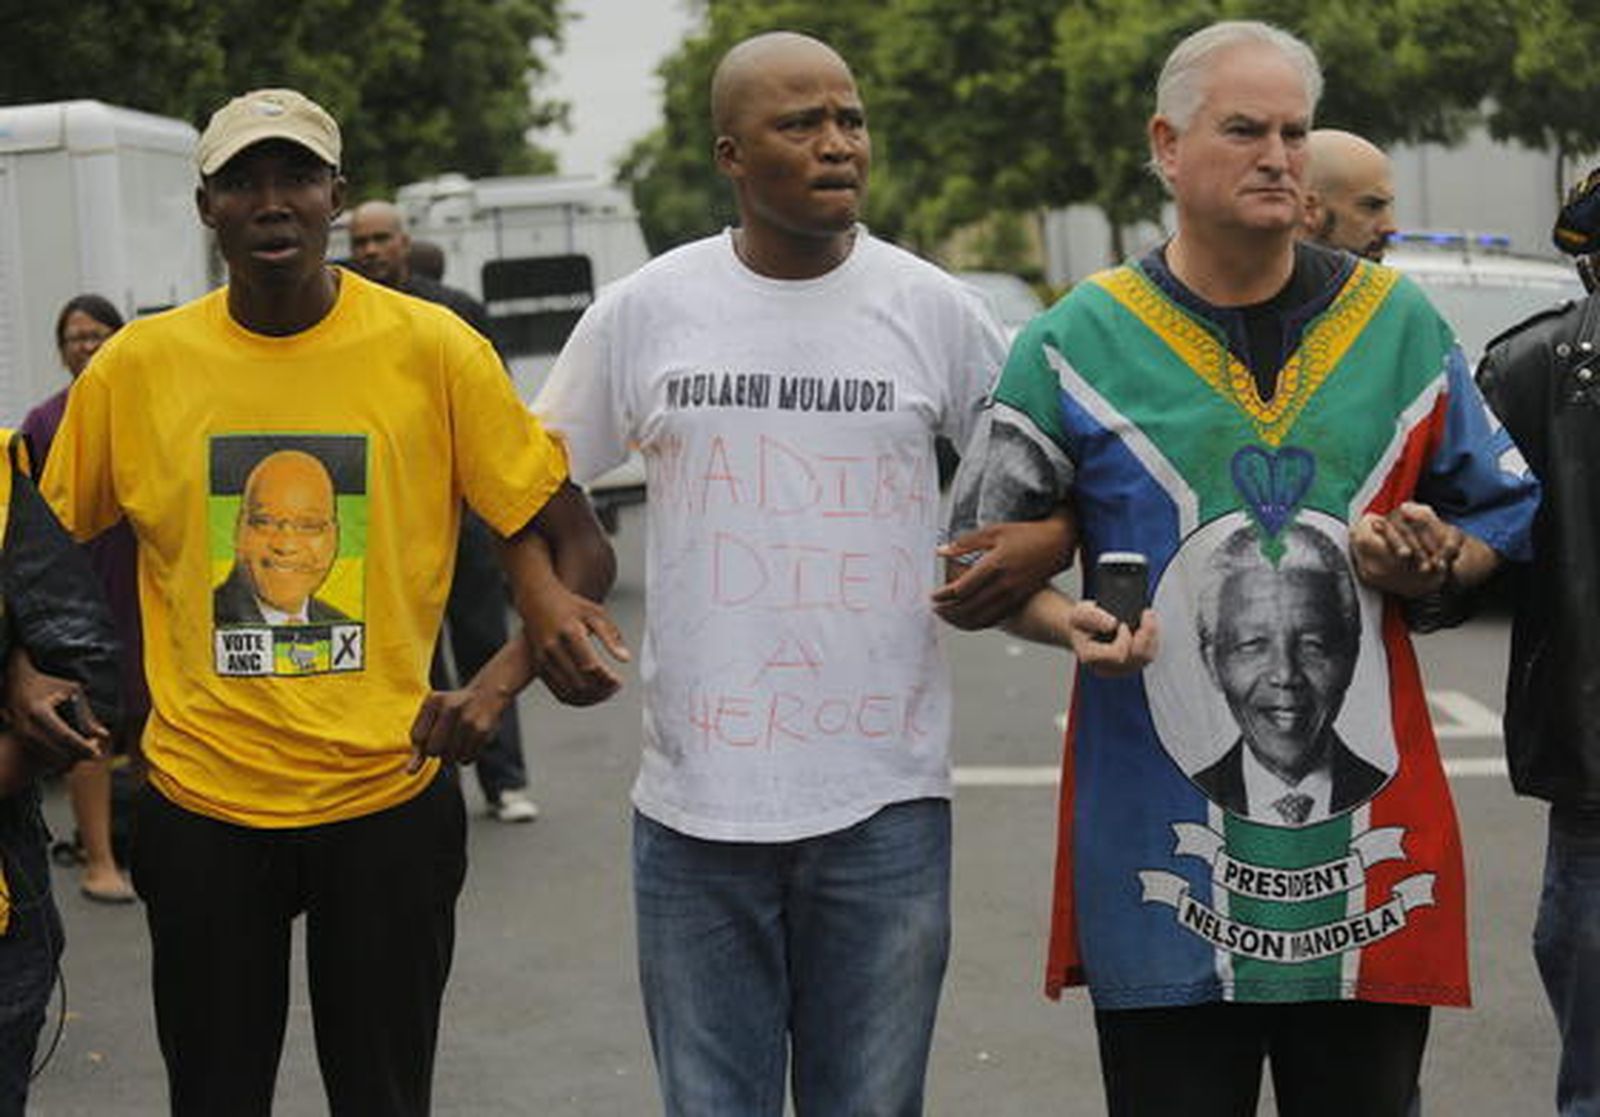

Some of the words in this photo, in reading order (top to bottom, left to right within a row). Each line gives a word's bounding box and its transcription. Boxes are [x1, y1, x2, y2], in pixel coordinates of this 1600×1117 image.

[778, 376, 895, 412] MULAUDZI
[711, 530, 922, 613] DIED
[222, 633, 264, 652] VOTE
[751, 634, 824, 686] A
[227, 653, 262, 671] ANC
[1224, 861, 1350, 898] PRESIDENT
[1184, 901, 1285, 959] NELSON
